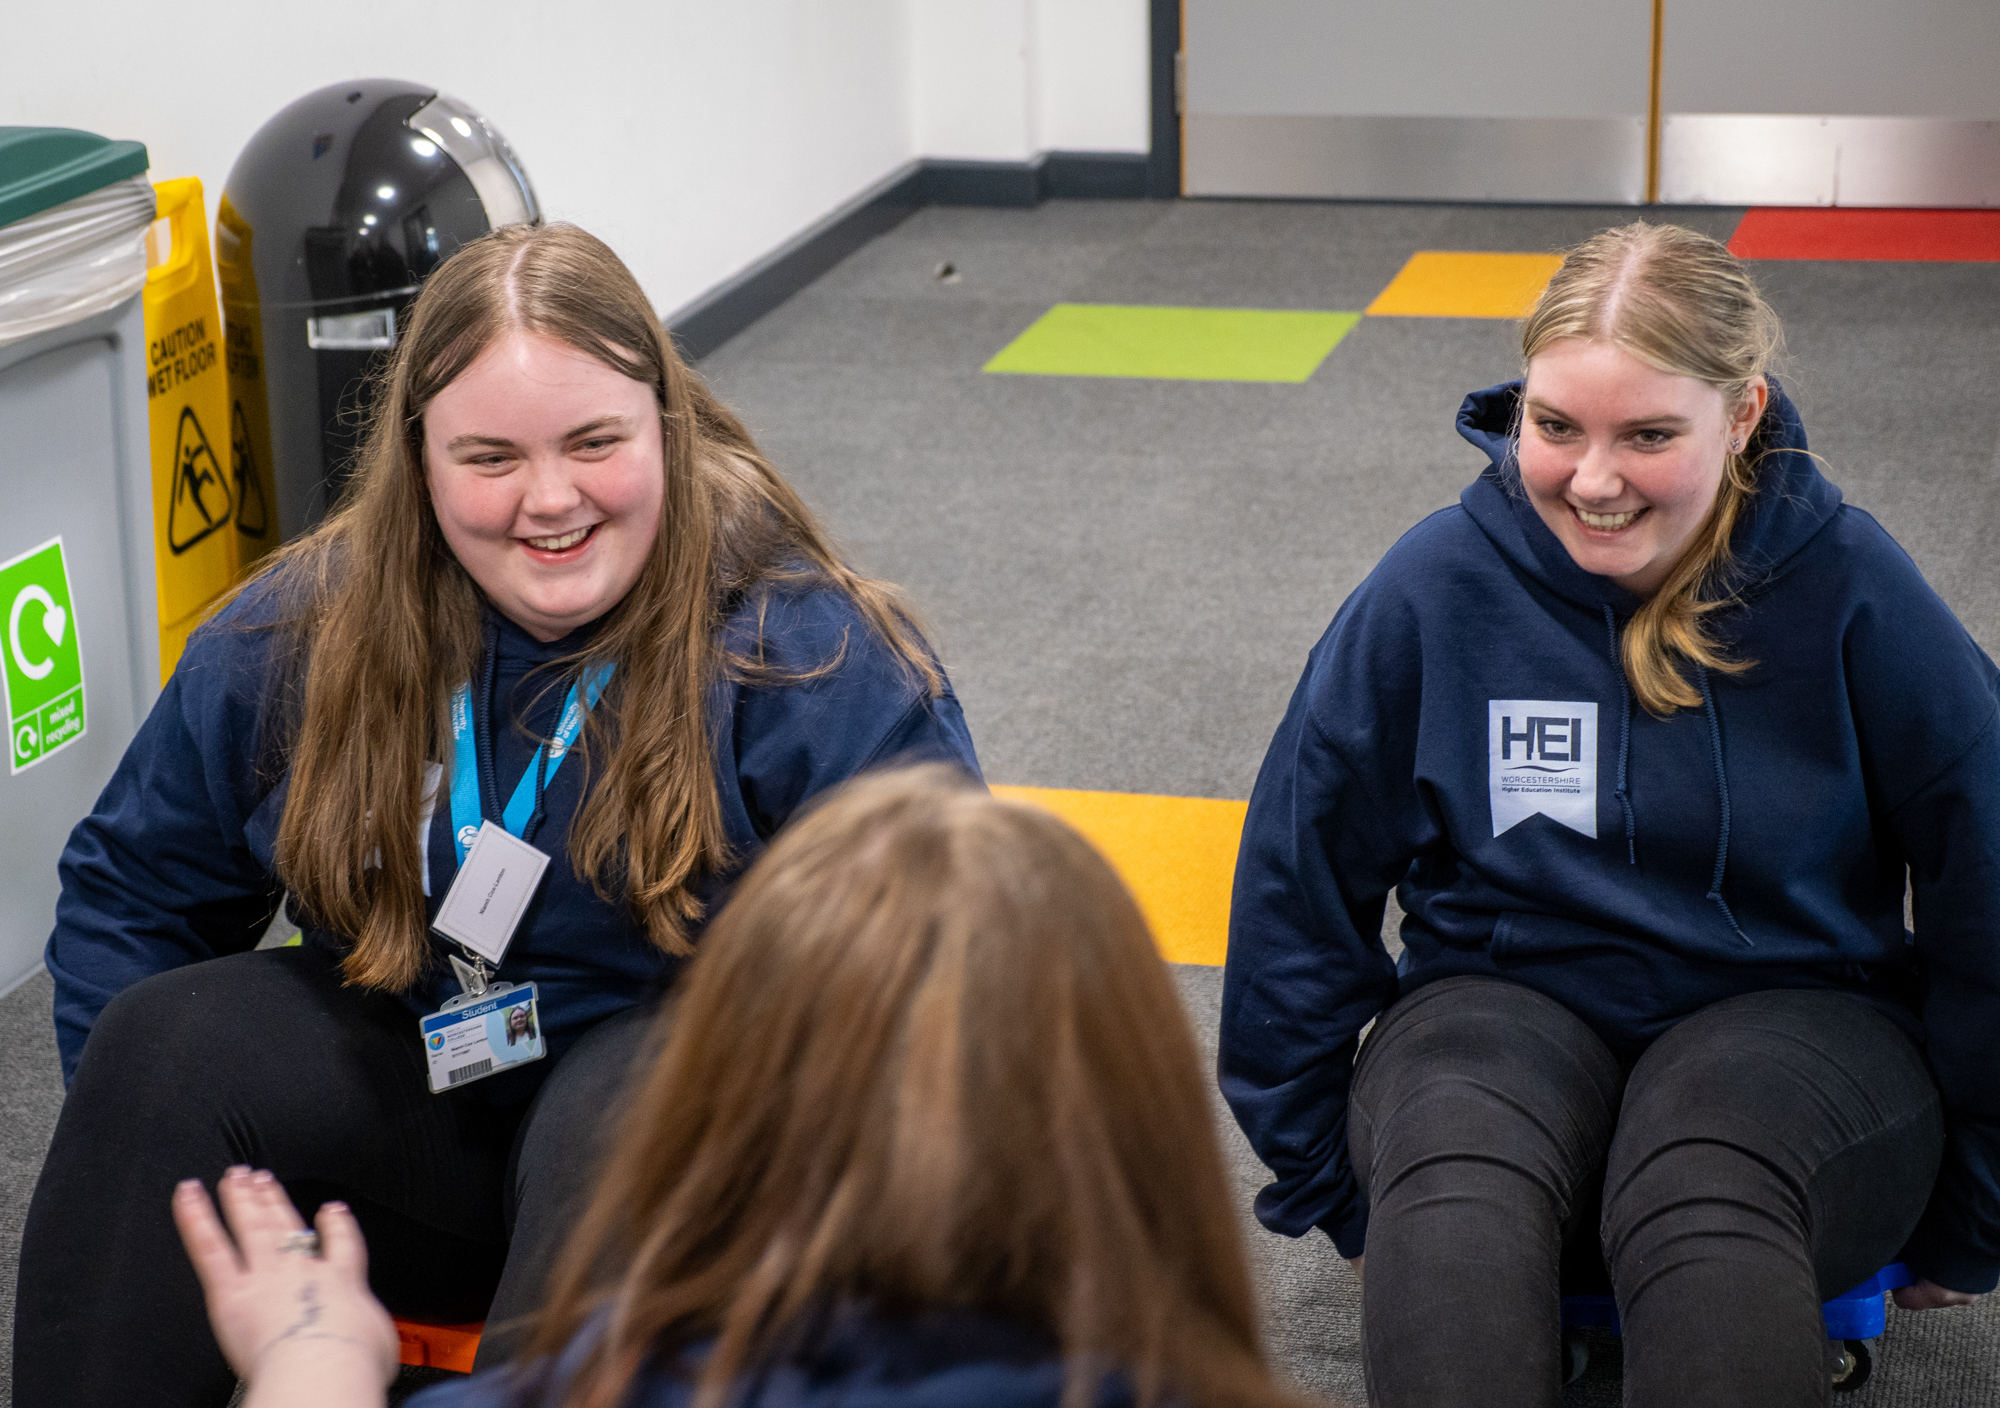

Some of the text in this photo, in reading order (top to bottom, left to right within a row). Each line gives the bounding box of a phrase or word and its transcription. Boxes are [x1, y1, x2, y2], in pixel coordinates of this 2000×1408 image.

[150, 318, 205, 367] CAUTION
[174, 342, 217, 386] FLOOR
[50, 697, 75, 725] mixed
[46, 716, 80, 745] recycling
[1502, 716, 1581, 762] HEI
[1501, 775, 1581, 785] WORCESTERSHIRE
[462, 1001, 498, 1020] Student
